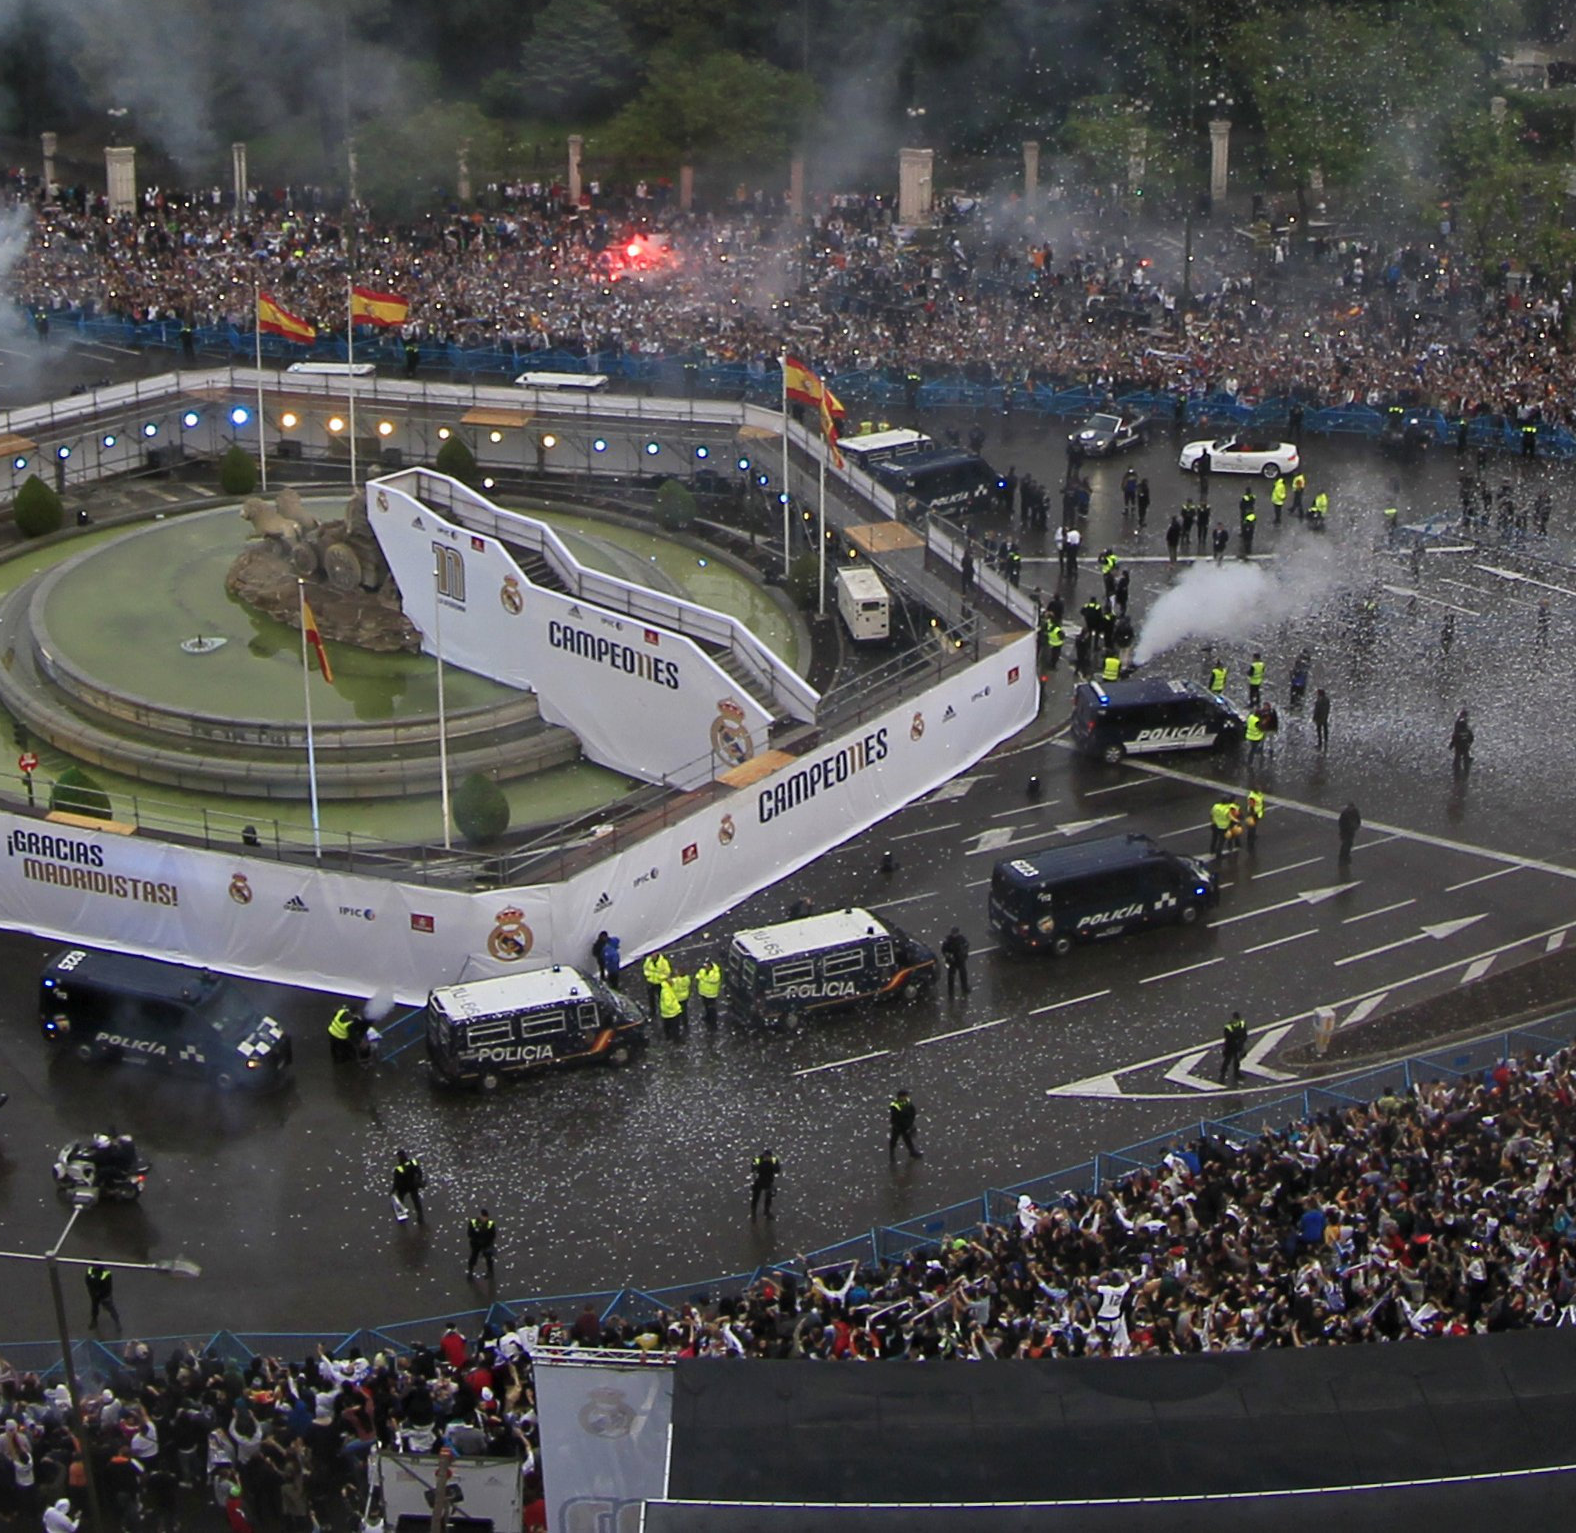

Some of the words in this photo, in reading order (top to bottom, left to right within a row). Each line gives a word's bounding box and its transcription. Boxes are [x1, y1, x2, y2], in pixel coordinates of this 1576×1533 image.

[7, 829, 104, 867] ¡GRACIAS
[24, 858, 178, 907] MADRIDISTAS!
[339, 906, 362, 917] IPIC
[95, 1031, 168, 1056] POLICÍA
[478, 1045, 554, 1062] POLICIA
